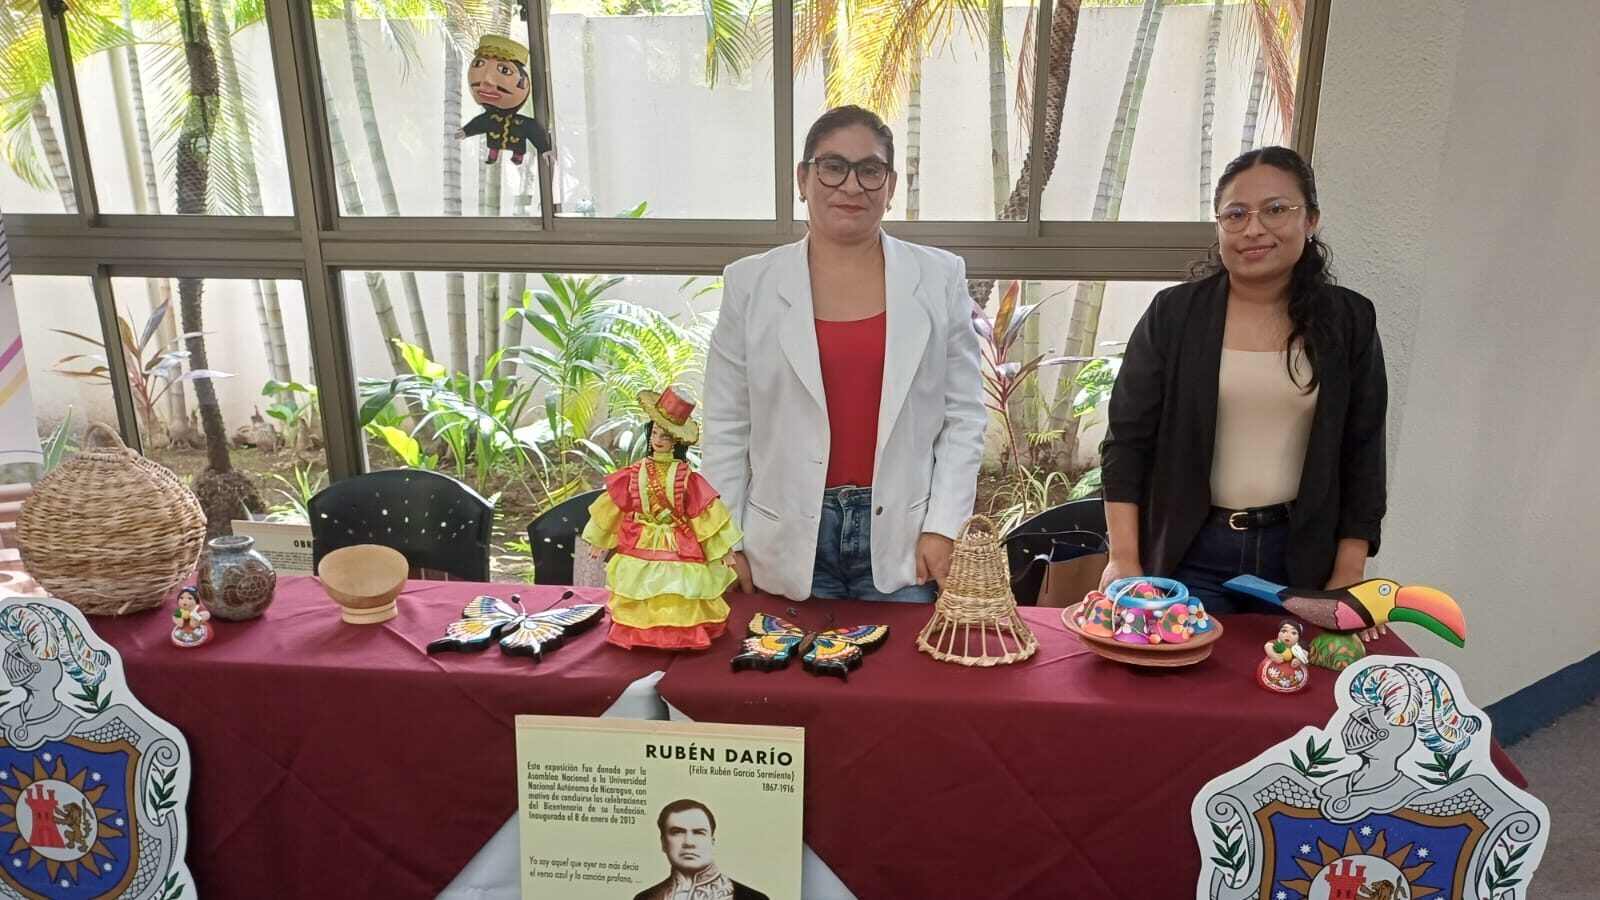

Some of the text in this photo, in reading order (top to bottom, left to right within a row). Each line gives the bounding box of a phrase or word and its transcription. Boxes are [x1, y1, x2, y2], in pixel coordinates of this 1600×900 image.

[646, 743, 792, 766] RUBÉN DARÍO
[545, 764, 578, 772] exposición
[582, 764, 592, 772] fue
[640, 767, 646, 775] la
[710, 767, 731, 776] Rubén
[757, 770, 794, 782] Sarmiento)
[528, 772, 558, 780] Asamblea
[562, 773, 589, 782] Nacional
[600, 775, 606, 783] la
[609, 776, 646, 785] Universidad
[528, 782, 555, 790] Nacional
[557, 783, 589, 792] Autónoma
[591, 784, 598, 792] de
[600, 785, 634, 796] Nicaragua,
[762, 782, 794, 792] 1867-1916
[552, 792, 559, 801] de
[561, 793, 592, 802] concluirse
[594, 794, 602, 803] las
[605, 795, 646, 805] celebraciones
[529, 801, 538, 809] del
[544, 802, 582, 811] Bicentenario
[588, 804, 595, 812] de
[568, 812, 573, 820] el
[581, 813, 588, 822] de
[610, 815, 618, 823] de
[620, 816, 635, 824] 2013
[529, 856, 537, 864] Yo
[539, 859, 550, 867] soy
[551, 858, 569, 868] aquel
[570, 861, 582, 869] que
[584, 861, 597, 870] ayer
[530, 868, 535, 877] el
[555, 870, 568, 879] azul
[575, 870, 581, 879] la
